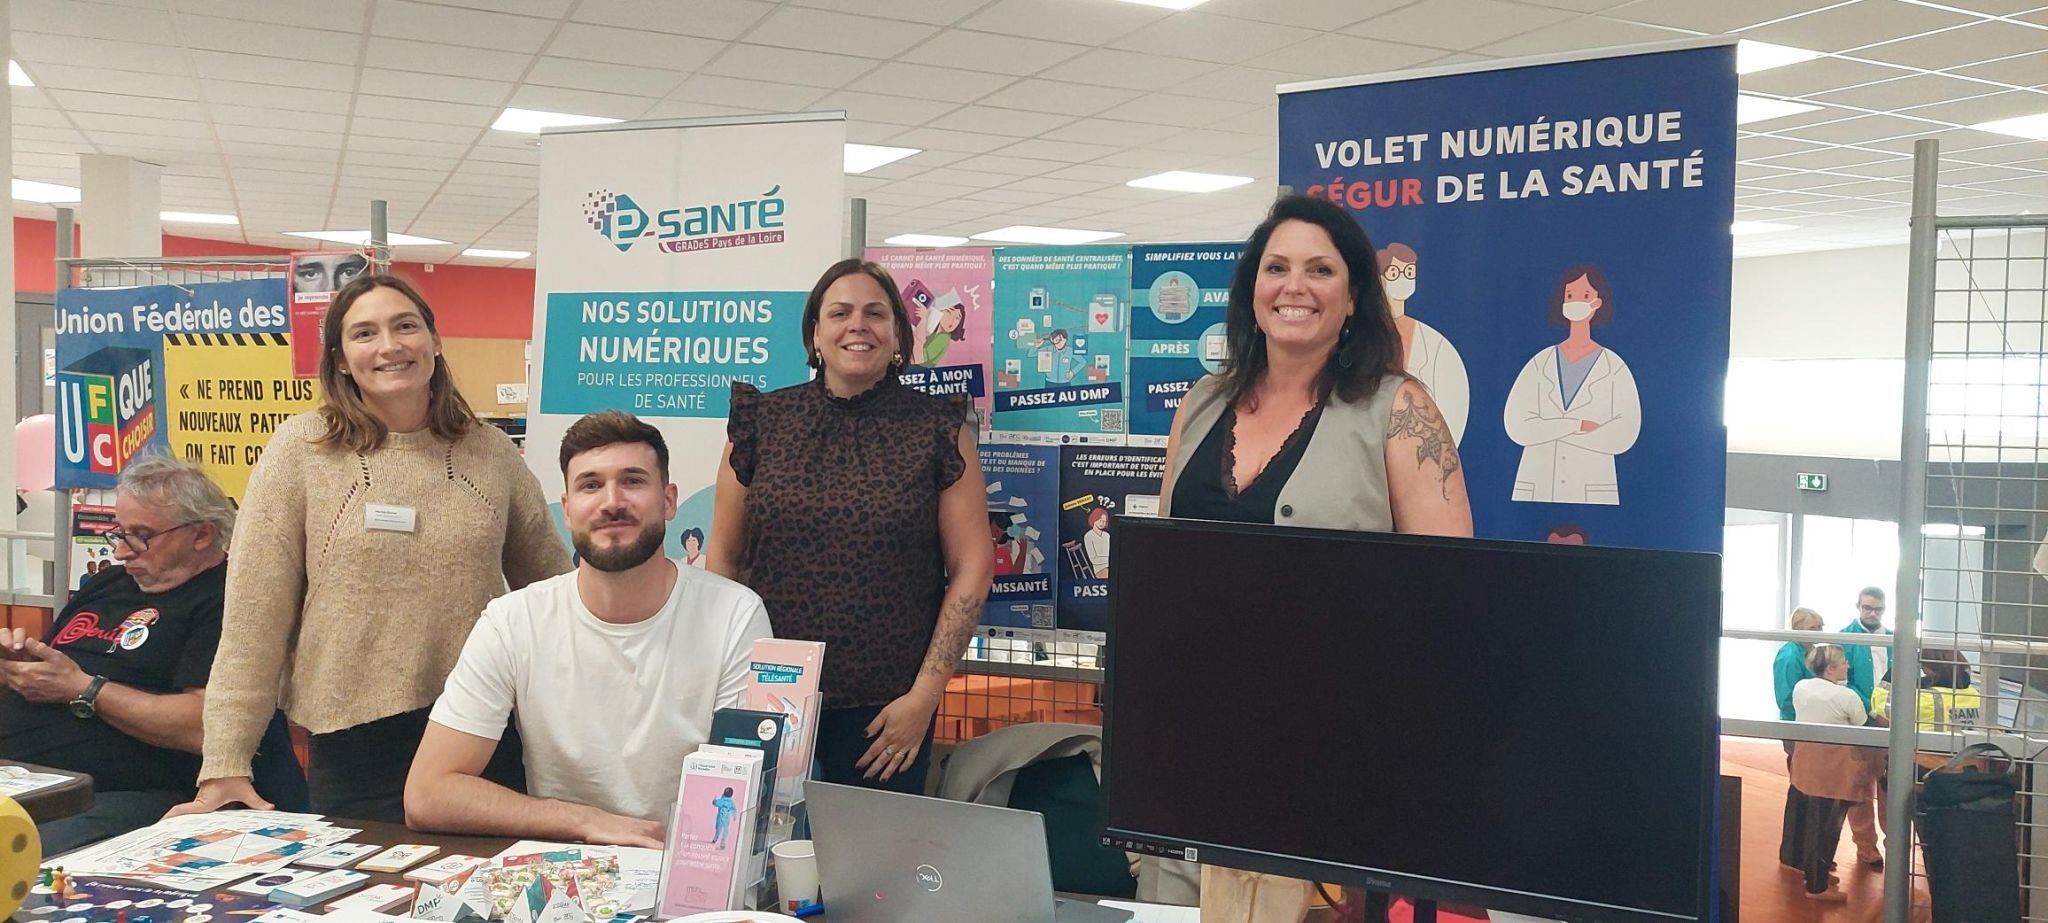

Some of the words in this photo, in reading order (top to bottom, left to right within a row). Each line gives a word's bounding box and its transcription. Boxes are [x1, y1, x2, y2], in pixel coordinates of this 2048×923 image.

[1315, 133, 1428, 169] VOLET
[1441, 110, 1682, 160] NUMÉRIQUE
[1437, 175, 1484, 204] DE
[1499, 169, 1549, 200] LA
[1562, 149, 1704, 196] SANTÉ
[675, 239, 709, 251] GRADeS
[713, 238, 732, 248] Pays
[735, 235, 745, 246] de
[747, 234, 756, 244] la
[759, 233, 782, 243] Loire
[999, 255, 1011, 263] DES
[1011, 254, 1042, 263] DONNÉES
[1043, 255, 1052, 263] DE
[1053, 254, 1075, 263] SANTÉ
[1145, 252, 1195, 262] SIMPLIFIEZ
[1196, 251, 1222, 261] VOUS
[1223, 251, 1235, 260] LA
[1020, 263, 1044, 271] QUAND
[1083, 263, 1117, 271] PRATIQUE
[1203, 291, 1230, 303] AVA
[54, 306, 123, 335] Union
[132, 301, 232, 333] Fédérale
[239, 298, 286, 328] des
[582, 301, 630, 324] NOS
[637, 299, 773, 324] SOLUTIONS
[579, 329, 769, 364] NUMÉRIQUES
[1151, 341, 1190, 354] APRÈS
[578, 373, 615, 386] POUR
[619, 374, 642, 387] LES
[898, 373, 925, 386] SSEZ
[929, 370, 938, 383] À
[942, 368, 973, 382] MON
[118, 358, 152, 421] QUE
[197, 379, 212, 400] NE
[219, 379, 264, 401] PREND
[273, 379, 313, 401] PLUS
[929, 379, 968, 395] SANTÉ
[1148, 381, 1189, 394] PASSEZ
[635, 394, 652, 409] DE
[657, 391, 706, 410] SANTÉ
[1010, 392, 1056, 407] PASSEZ
[1058, 391, 1077, 403] AU
[1080, 388, 1110, 401] DMP
[179, 411, 242, 433] NOUVEAUX
[122, 411, 153, 460] CHOISIR
[185, 443, 203, 463] ON
[211, 444, 236, 465] FAIT
[245, 445, 264, 466] CO
[1118, 455, 1166, 463] D'IDENTIFICAT
[1089, 461, 1130, 469] IMPORTANT
[1094, 469, 1116, 477] PLACE
[1136, 470, 1147, 478] LES
[1148, 469, 1164, 478] ÉVIT
[992, 578, 1049, 594] MSSANTÉ
[1073, 585, 1108, 598] PASS
[752, 663, 776, 671] SOLUTION
[776, 665, 803, 674] RÉGIONALE
[761, 673, 793, 683] TÉLÉSANTÉ
[919, 872, 940, 883] DELL
[417, 895, 440, 915] DMP
